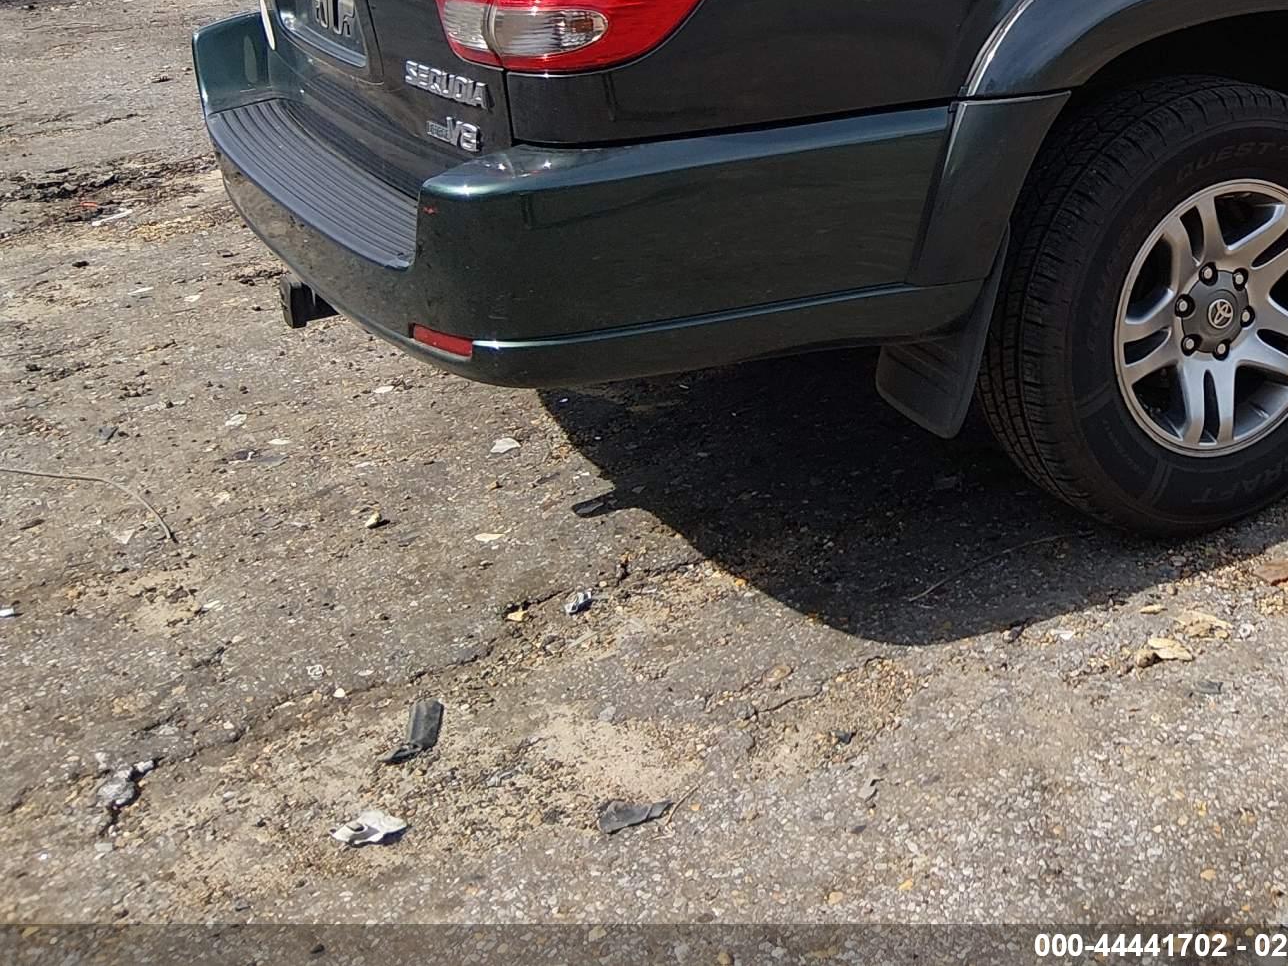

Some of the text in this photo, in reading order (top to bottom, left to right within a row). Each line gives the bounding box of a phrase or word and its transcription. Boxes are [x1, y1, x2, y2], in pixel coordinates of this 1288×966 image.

[404, 60, 488, 110] SEQUOIA
[445, 116, 481, 152] V8
[1175, 140, 1276, 184] QUEST
